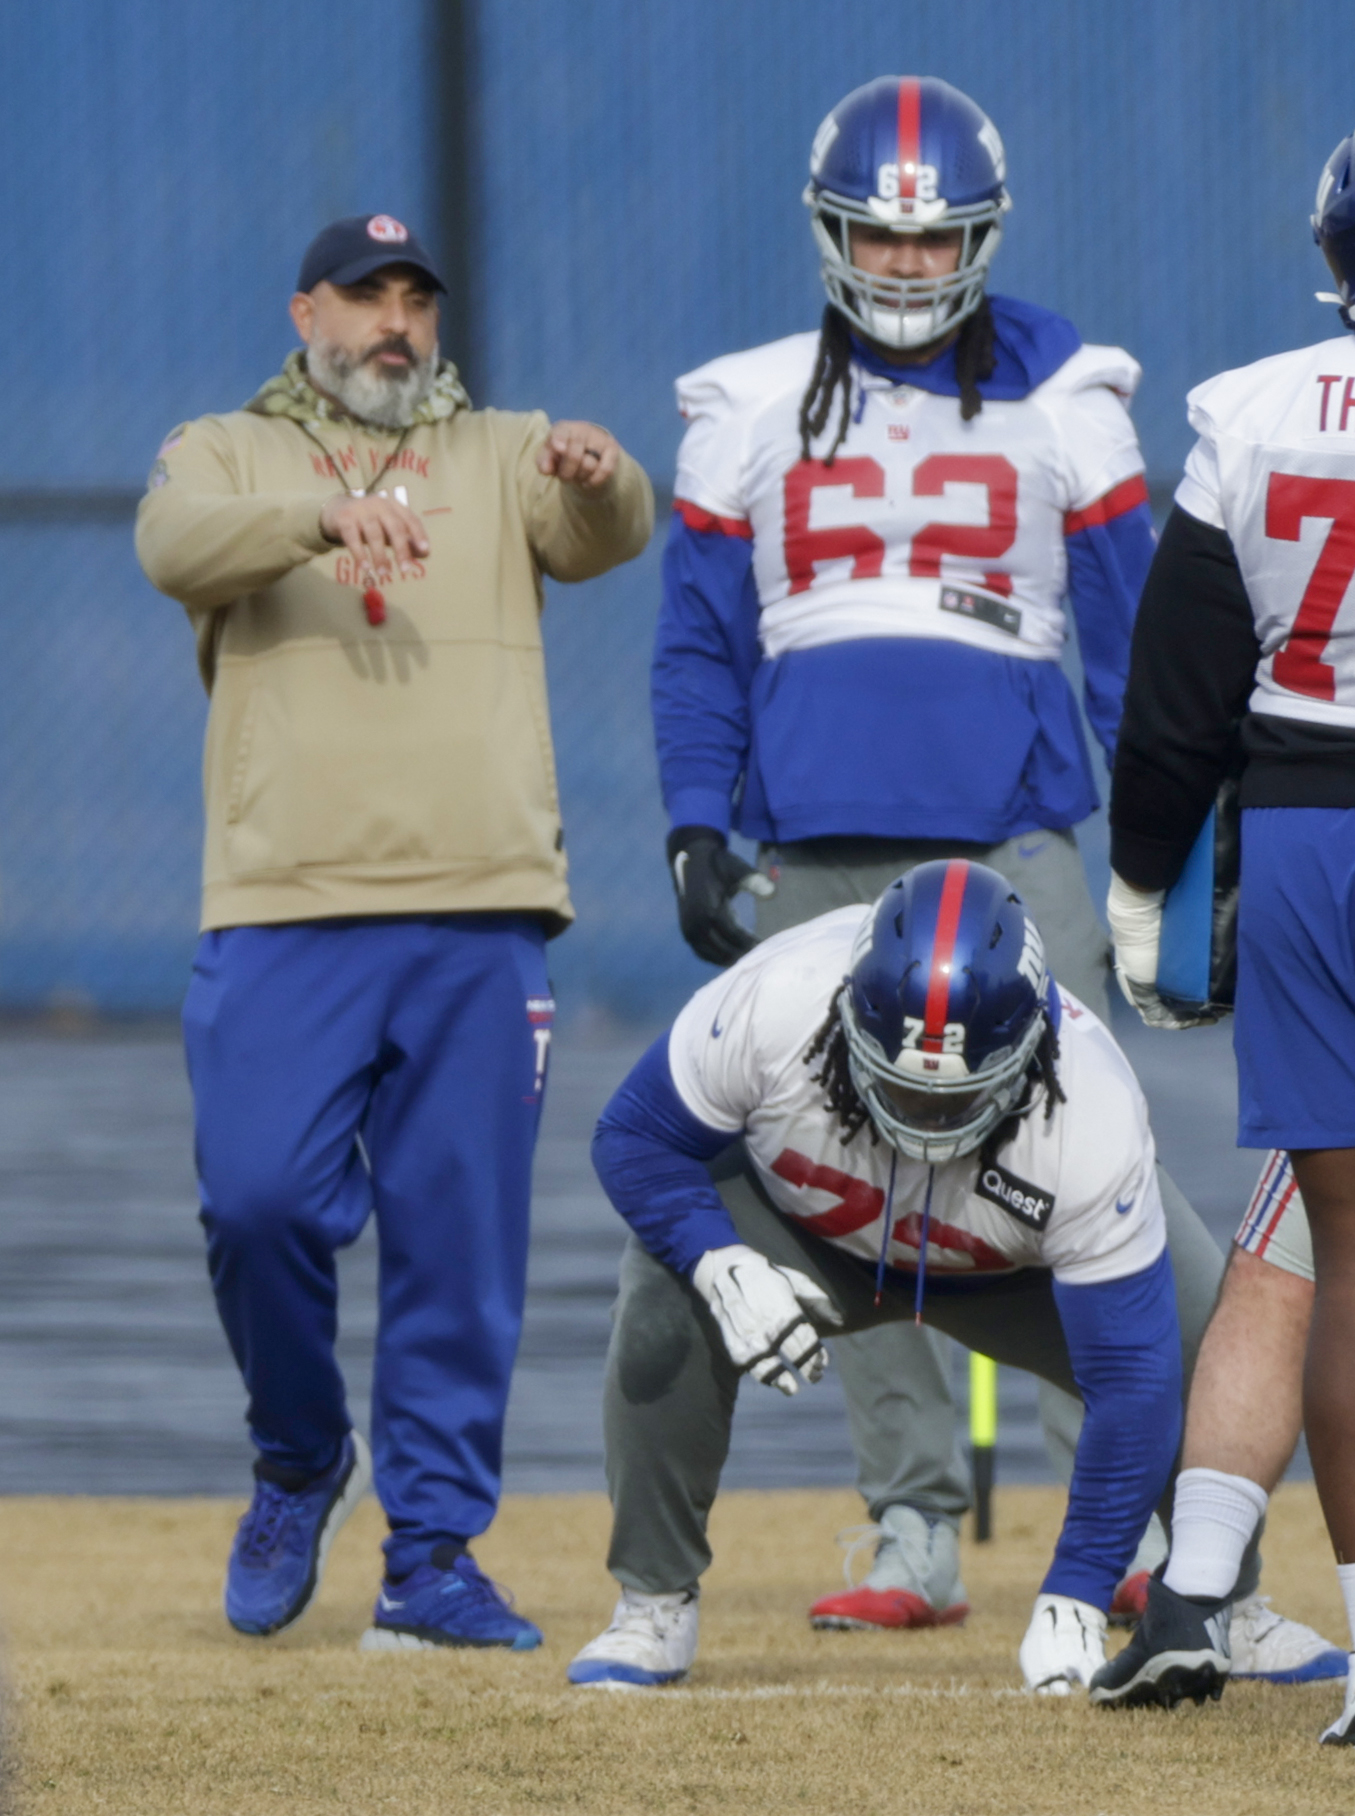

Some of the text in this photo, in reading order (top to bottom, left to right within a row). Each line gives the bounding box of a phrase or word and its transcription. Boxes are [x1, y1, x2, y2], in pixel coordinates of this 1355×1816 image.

[878, 163, 938, 200] 62
[783, 454, 1019, 598] 62
[335, 555, 427, 586] GINS
[901, 1016, 965, 1054] 72
[982, 1169, 1047, 1221] Quest
